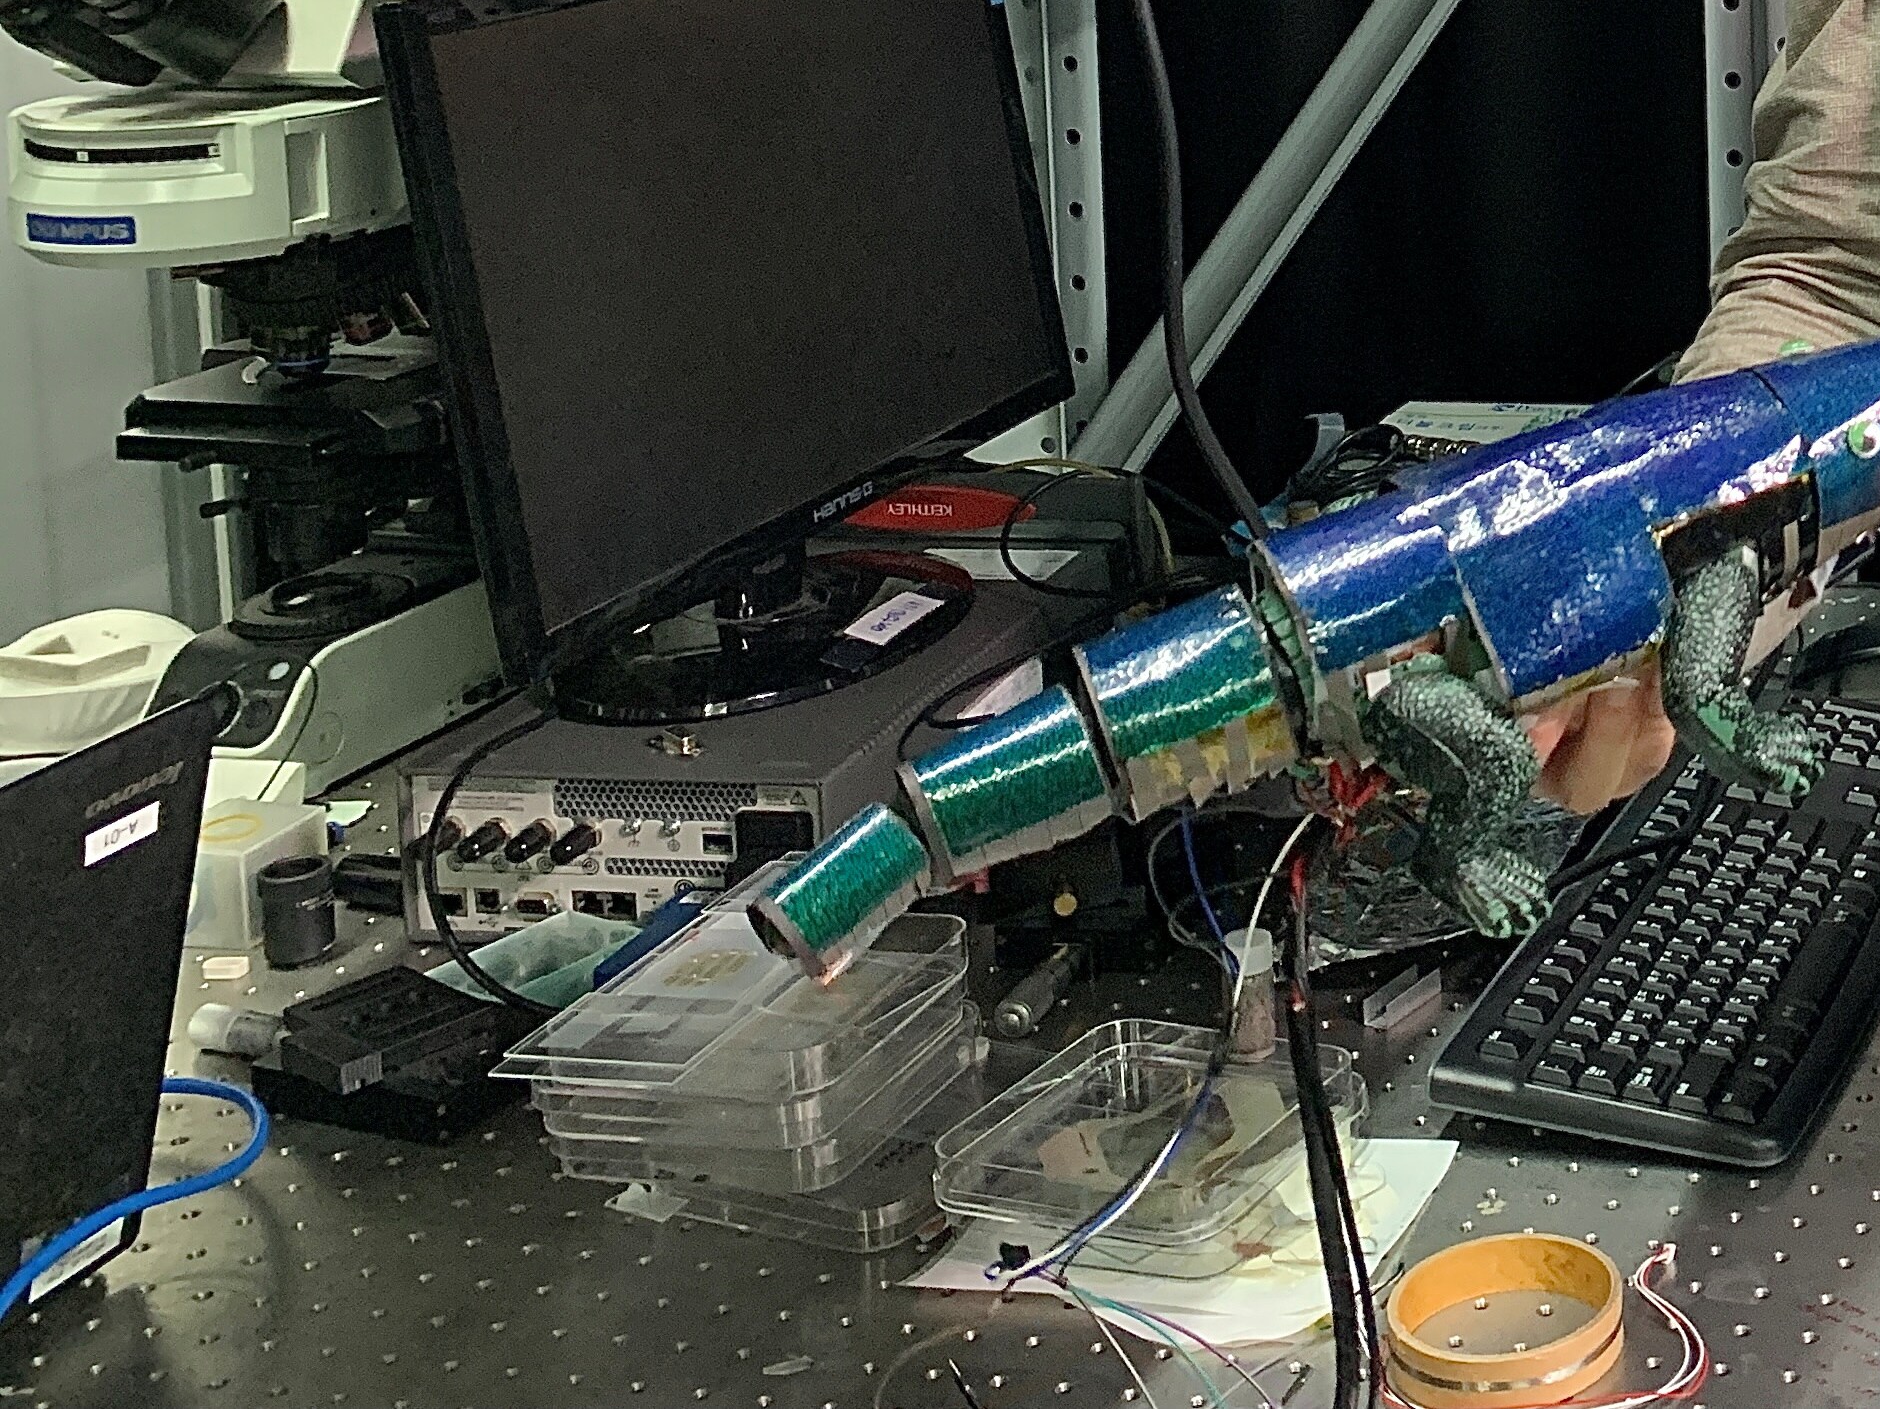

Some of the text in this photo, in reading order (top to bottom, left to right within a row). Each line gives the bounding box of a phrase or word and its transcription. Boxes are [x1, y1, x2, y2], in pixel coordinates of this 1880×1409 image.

[30, 220, 130, 240] OLYMPUS
[887, 502, 953, 518] KEITHLEY
[103, 818, 139, 849] A-01
